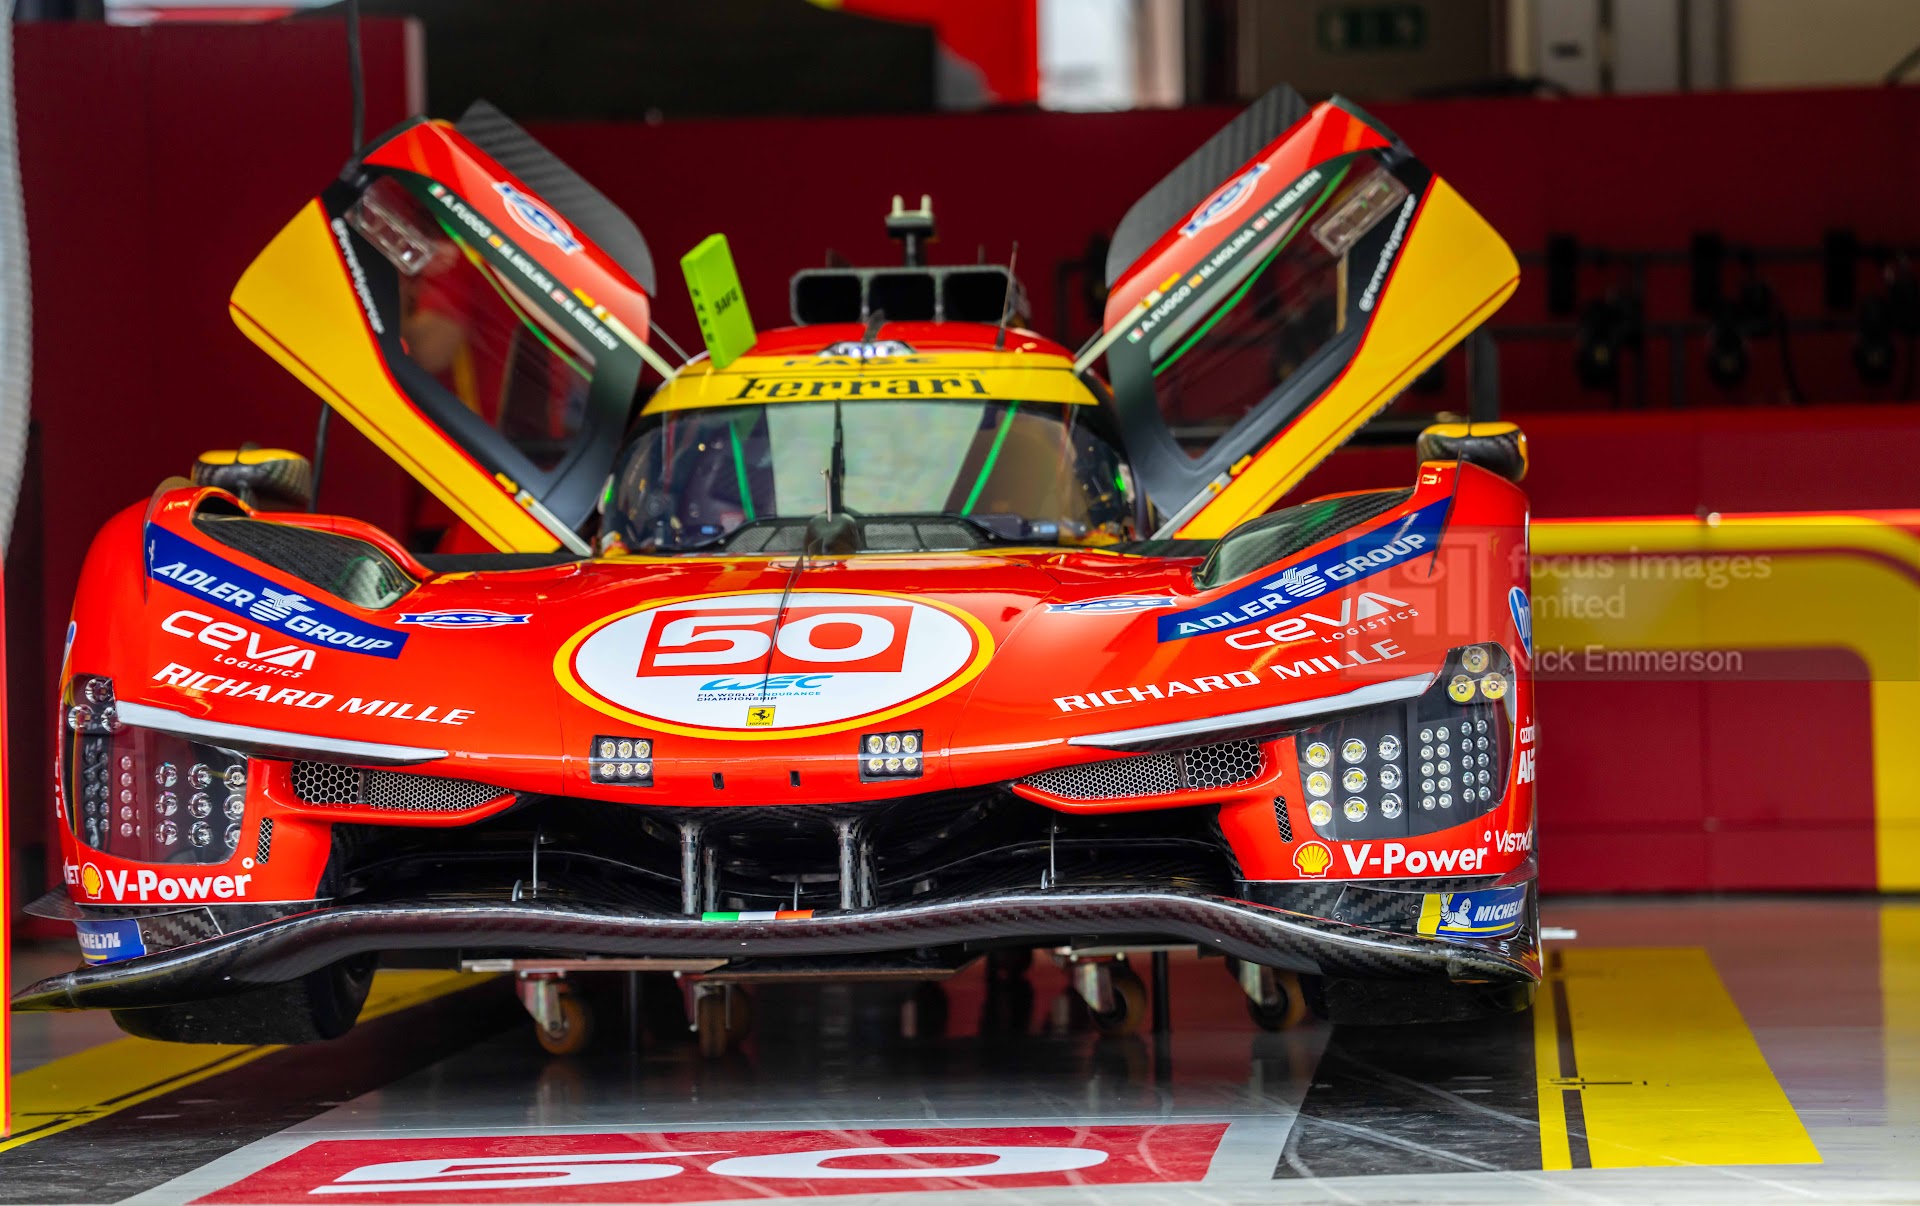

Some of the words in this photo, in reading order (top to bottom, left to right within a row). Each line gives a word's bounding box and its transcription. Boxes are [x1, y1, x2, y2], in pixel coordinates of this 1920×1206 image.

[714, 287, 738, 315] SAFE
[727, 374, 990, 400] Ferrari
[1177, 592, 1291, 635] ADLER
[1324, 534, 1426, 581] GROUP
[153, 562, 255, 608] ADLER
[284, 614, 393, 650] GROUP
[652, 613, 895, 666] 50
[1321, 608, 1419, 643] LOGISTICS
[213, 653, 304, 679] LOGISTICS
[700, 675, 834, 690] WEC
[1053, 670, 1261, 713] RICHARD
[1269, 638, 1406, 680] MILLE
[152, 662, 335, 710] RICHARD
[336, 697, 476, 726] MILLE
[1342, 843, 1488, 875] V-Power
[105, 869, 252, 901] V-Power
[308, 1146, 1109, 1194] 50
